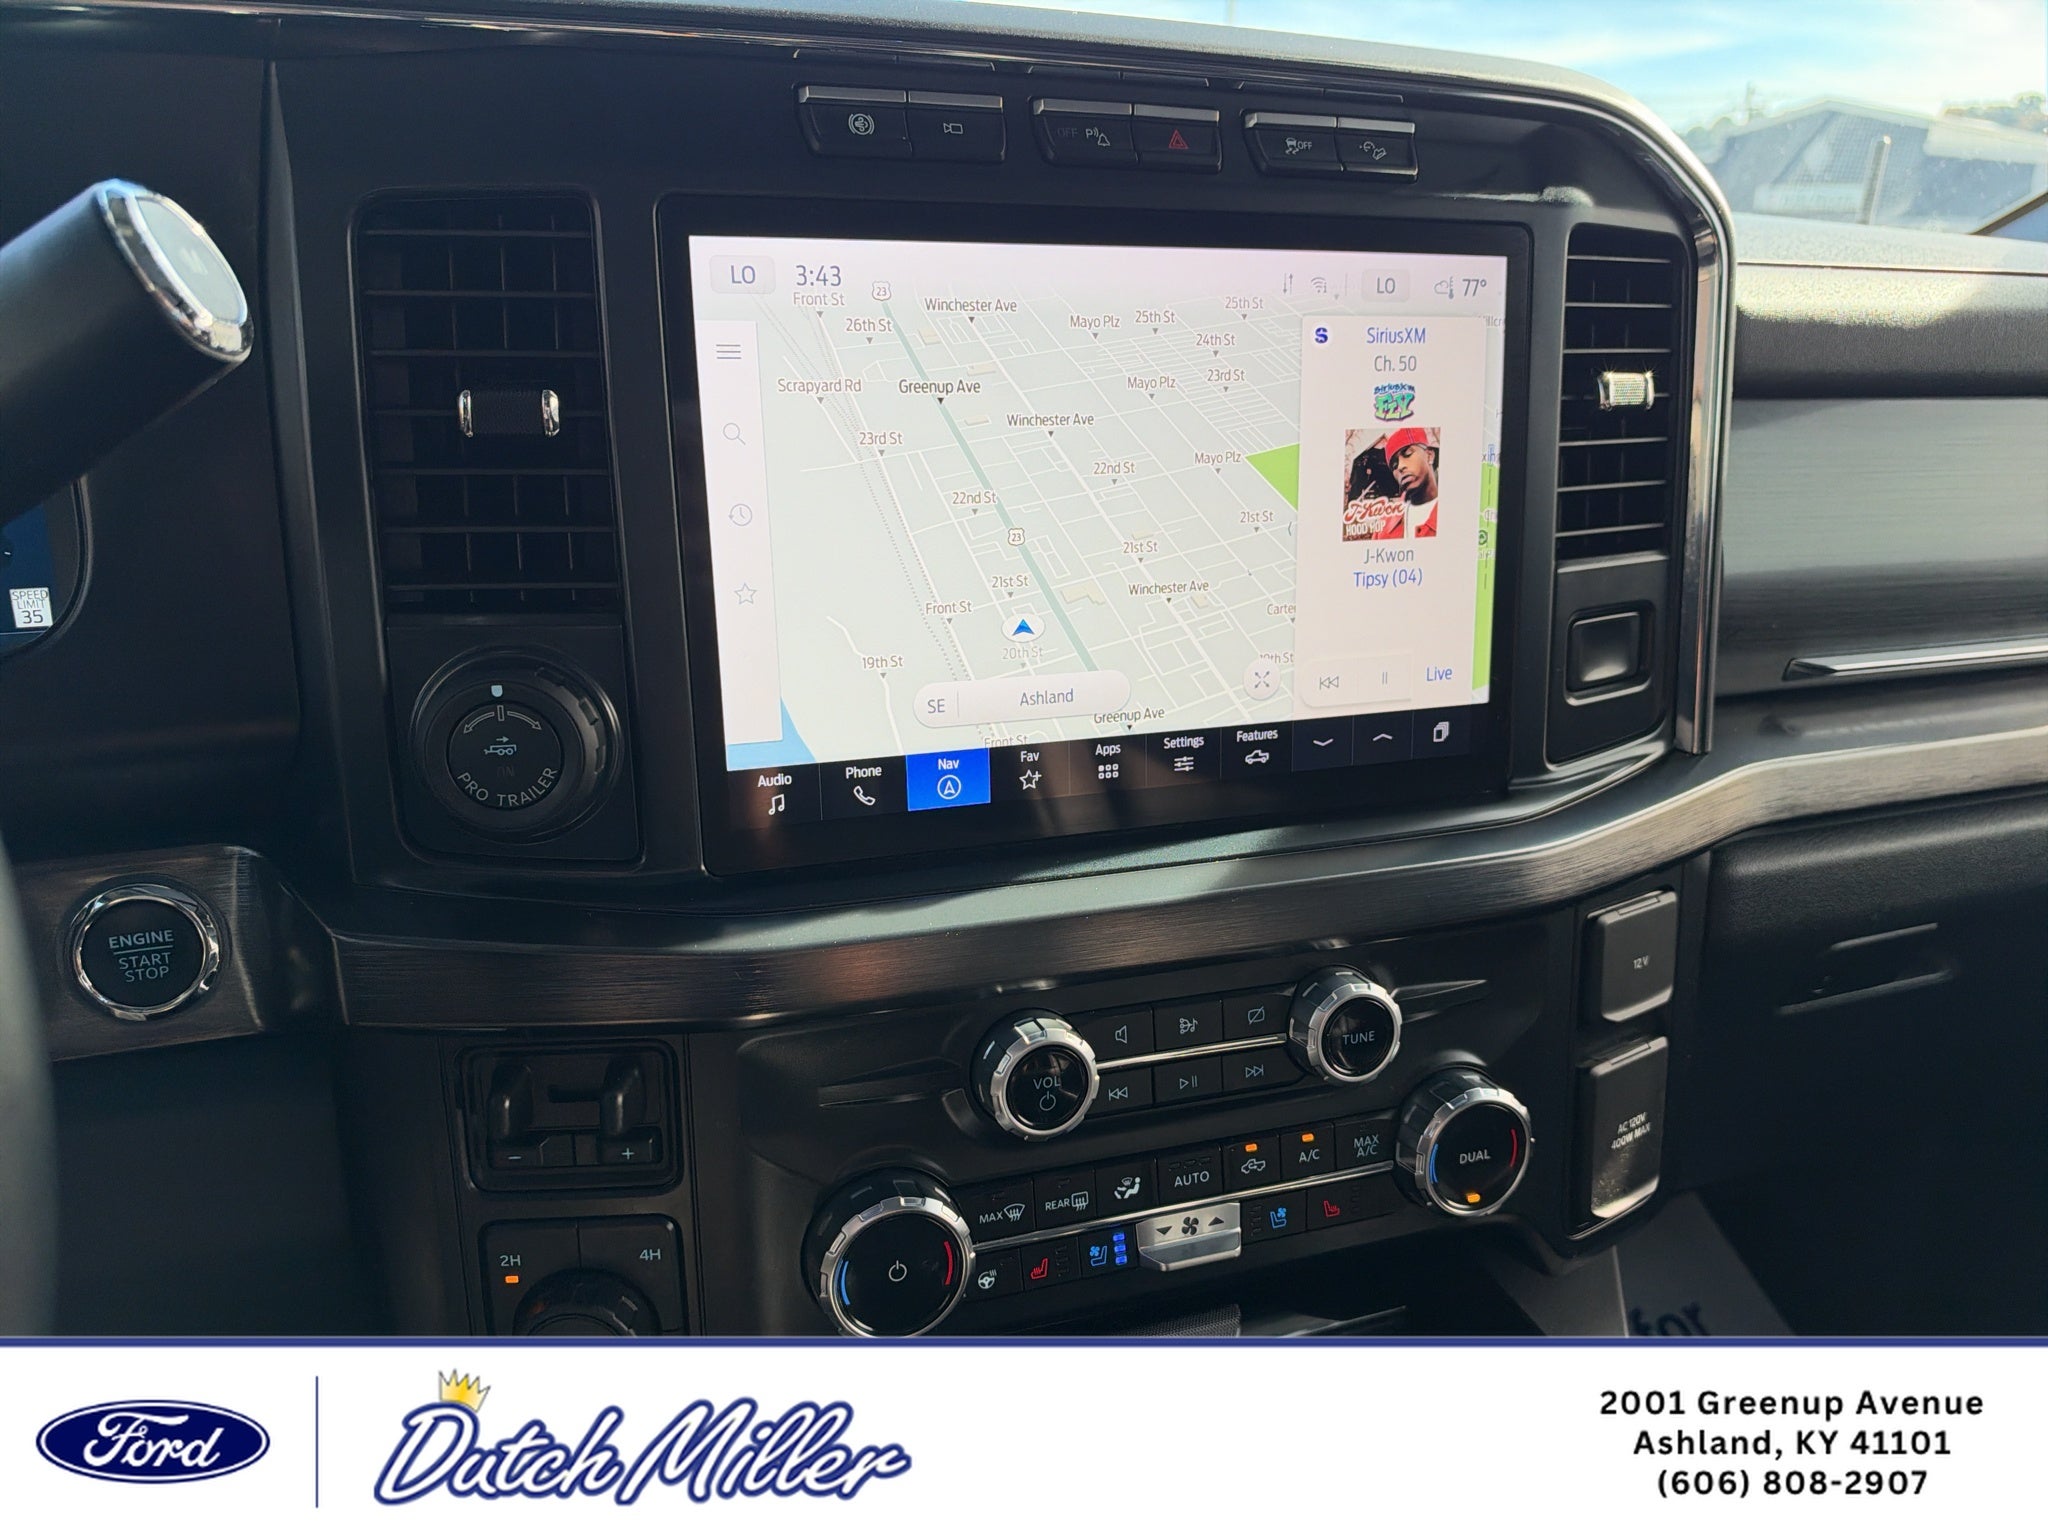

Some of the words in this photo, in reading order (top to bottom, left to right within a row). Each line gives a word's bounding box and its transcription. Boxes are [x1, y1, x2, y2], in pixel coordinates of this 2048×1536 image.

[1297, 141, 1312, 150] OFF
[730, 265, 756, 285] LO
[796, 265, 842, 287] 3:43
[876, 286, 887, 297] 23
[1376, 278, 1396, 294] LO
[793, 293, 828, 306] Front
[830, 292, 845, 306] St
[925, 298, 992, 313] Winchester
[995, 299, 1017, 312] Ave
[1225, 297, 1249, 310] 25th
[1251, 297, 1263, 310] St
[1070, 315, 1102, 330] Mayo
[1104, 315, 1120, 328] Plz
[1135, 311, 1160, 324] 25th
[1162, 311, 1175, 324] St
[845, 319, 874, 332] 26th
[878, 318, 892, 331] St
[1196, 334, 1220, 347] 24th
[1222, 333, 1235, 346] St
[1366, 327, 1426, 344] SiriusXM
[1374, 355, 1395, 373] Ch.
[1399, 355, 1417, 373] 50
[1207, 369, 1231, 382] 23rd
[1233, 368, 1245, 382] St
[778, 379, 841, 394] Scrapyard
[845, 378, 861, 392] Rd
[899, 380, 953, 396] Greenup
[956, 380, 981, 393] Ave
[1127, 376, 1159, 391] Mayo
[1161, 376, 1176, 389] Plz
[1007, 413, 1070, 426] Winchester
[1073, 413, 1094, 426] Ave
[859, 432, 886, 446] 23rd
[889, 431, 903, 445] St
[1194, 452, 1225, 466] Mayo
[1227, 451, 1242, 464] Plz
[1094, 461, 1120, 475] 22nd
[1122, 461, 1136, 474] St
[952, 492, 980, 505] 22nd
[982, 491, 997, 504] St
[1240, 510, 1260, 523] 21st
[1262, 510, 1274, 522] St
[1346, 522, 1368, 536] HOOD
[1011, 532, 1021, 542] 23
[1123, 540, 1143, 554] 21st
[1145, 540, 1158, 553] St
[1364, 548, 1414, 565] J-Kwon
[991, 575, 1013, 588] 21st
[1016, 575, 1028, 587] St
[1353, 571, 1388, 589] Tipsy
[1392, 568, 1424, 587] (04)
[1127, 581, 1187, 595] Winchester
[1188, 579, 1209, 592] Ave
[12, 590, 48, 600] SPEED
[17, 600, 45, 609] LIMIT
[925, 602, 956, 615] Front
[958, 601, 972, 614] St
[22, 610, 43, 624] 35
[1002, 647, 1028, 660] 20th
[1031, 647, 1043, 659] St
[862, 656, 887, 669] 19th
[890, 655, 903, 668] St
[1426, 666, 1453, 682] Live
[1020, 689, 1074, 706] Ashland
[927, 699, 946, 714] SE
[1094, 709, 1141, 724] Greenup
[1144, 708, 1165, 720] Ave
[1164, 734, 1204, 751] Settings
[1236, 728, 1278, 743] Features
[1020, 750, 1040, 762] Fav
[1095, 743, 1121, 757] Apps
[938, 758, 959, 770] Nav
[845, 765, 882, 779] Phone
[457, 772, 489, 801] PRO
[497, 767, 559, 807] TRAILER
[758, 773, 792, 787] Audio
[109, 929, 174, 949] ENGINE
[119, 952, 171, 970] START
[124, 965, 170, 983] STOP
[1342, 1030, 1375, 1046] TUNE
[1033, 1076, 1061, 1089] VOL
[1617, 1121, 1629, 1135] AC
[1354, 1134, 1379, 1148] MAX
[1611, 1131, 1634, 1149] 400W
[1634, 1122, 1651, 1139] MAX
[1299, 1149, 1320, 1163] A/C
[1356, 1145, 1378, 1158] A/C
[1459, 1149, 1491, 1164] DUAL
[1174, 1171, 1210, 1187] AUTO
[1045, 1198, 1070, 1211] REAR
[979, 1211, 1003, 1224] MAX
[500, 1255, 521, 1267] 2H
[639, 1248, 661, 1261] 4H
